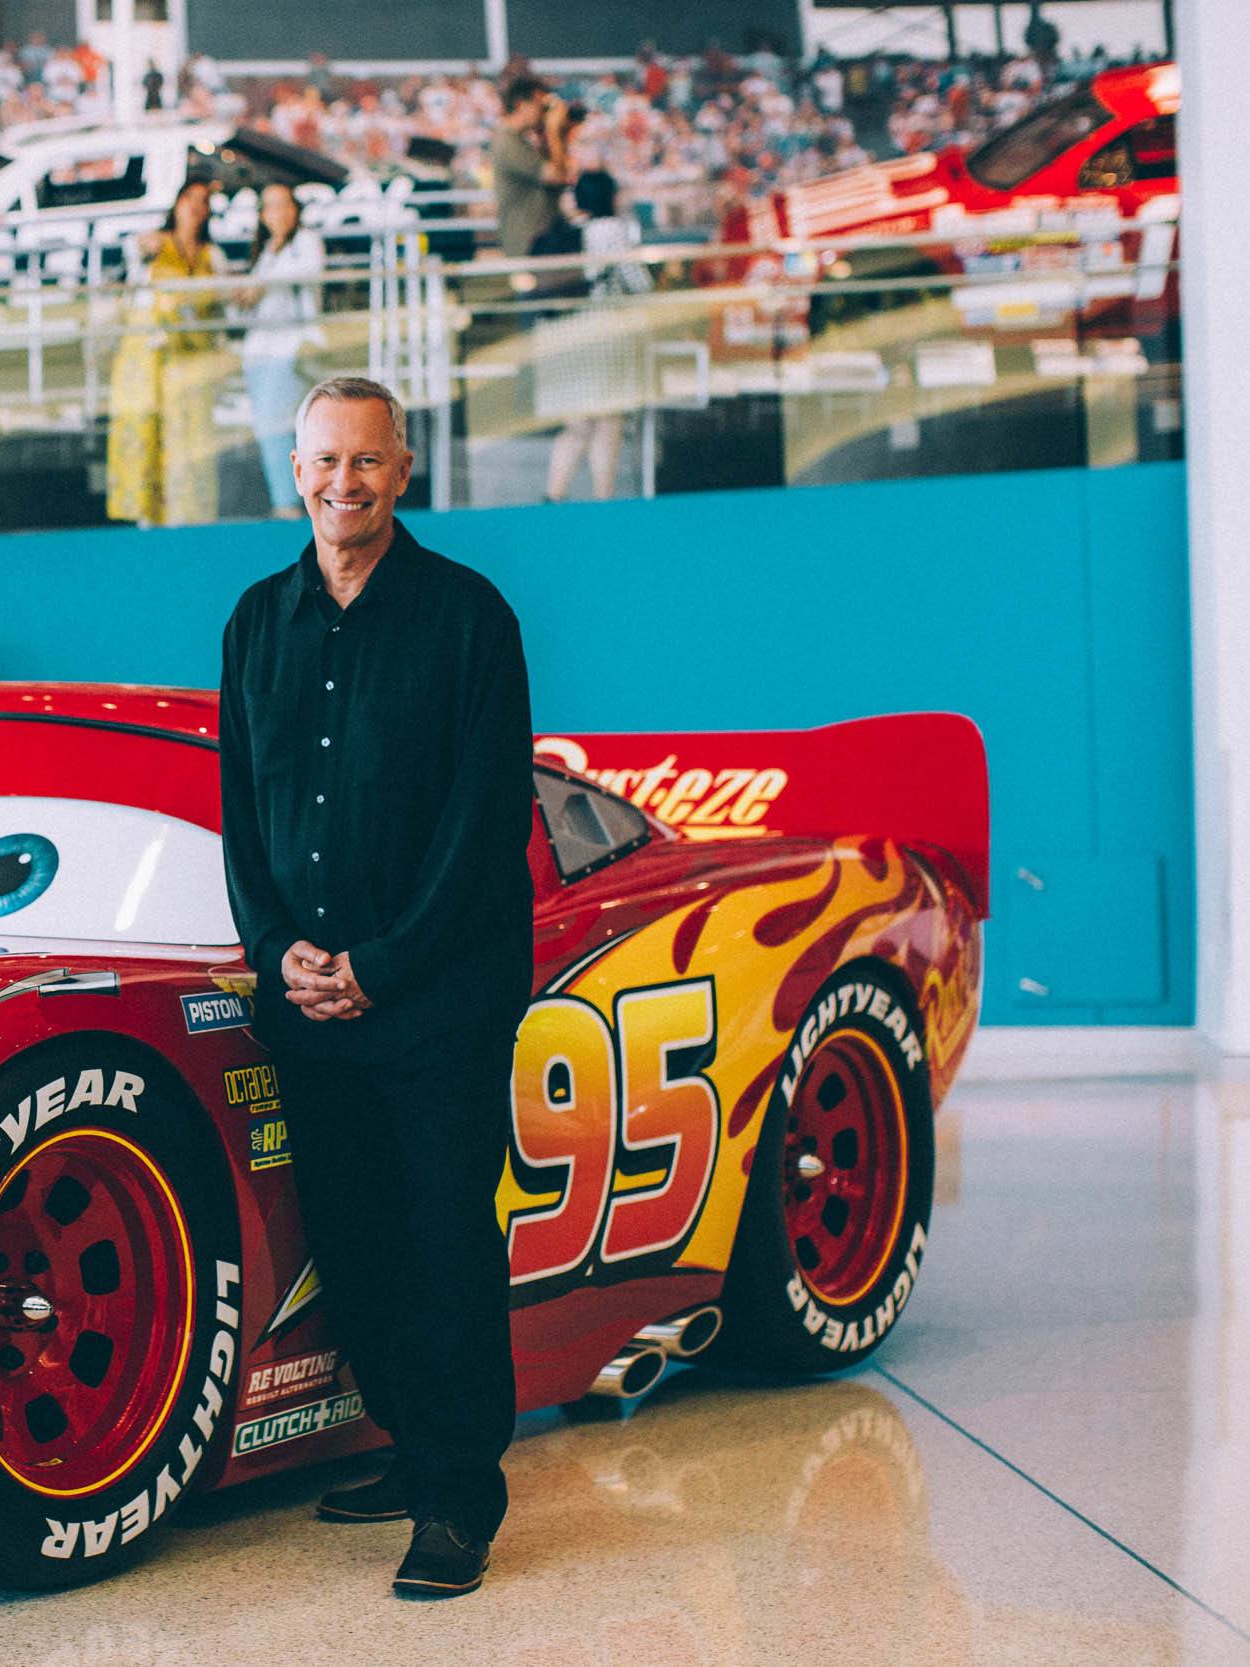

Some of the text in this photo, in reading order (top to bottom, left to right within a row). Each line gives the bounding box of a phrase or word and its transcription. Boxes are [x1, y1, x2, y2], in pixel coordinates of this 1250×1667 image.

[188, 997, 244, 1024] PISTON
[781, 982, 924, 1108] LIGHTYEAR
[262, 1120, 289, 1153] RP
[507, 979, 719, 1286] 95
[786, 1221, 928, 1353] LIGHTYEAR
[40, 1259, 241, 1559] LIGHTYEAR
